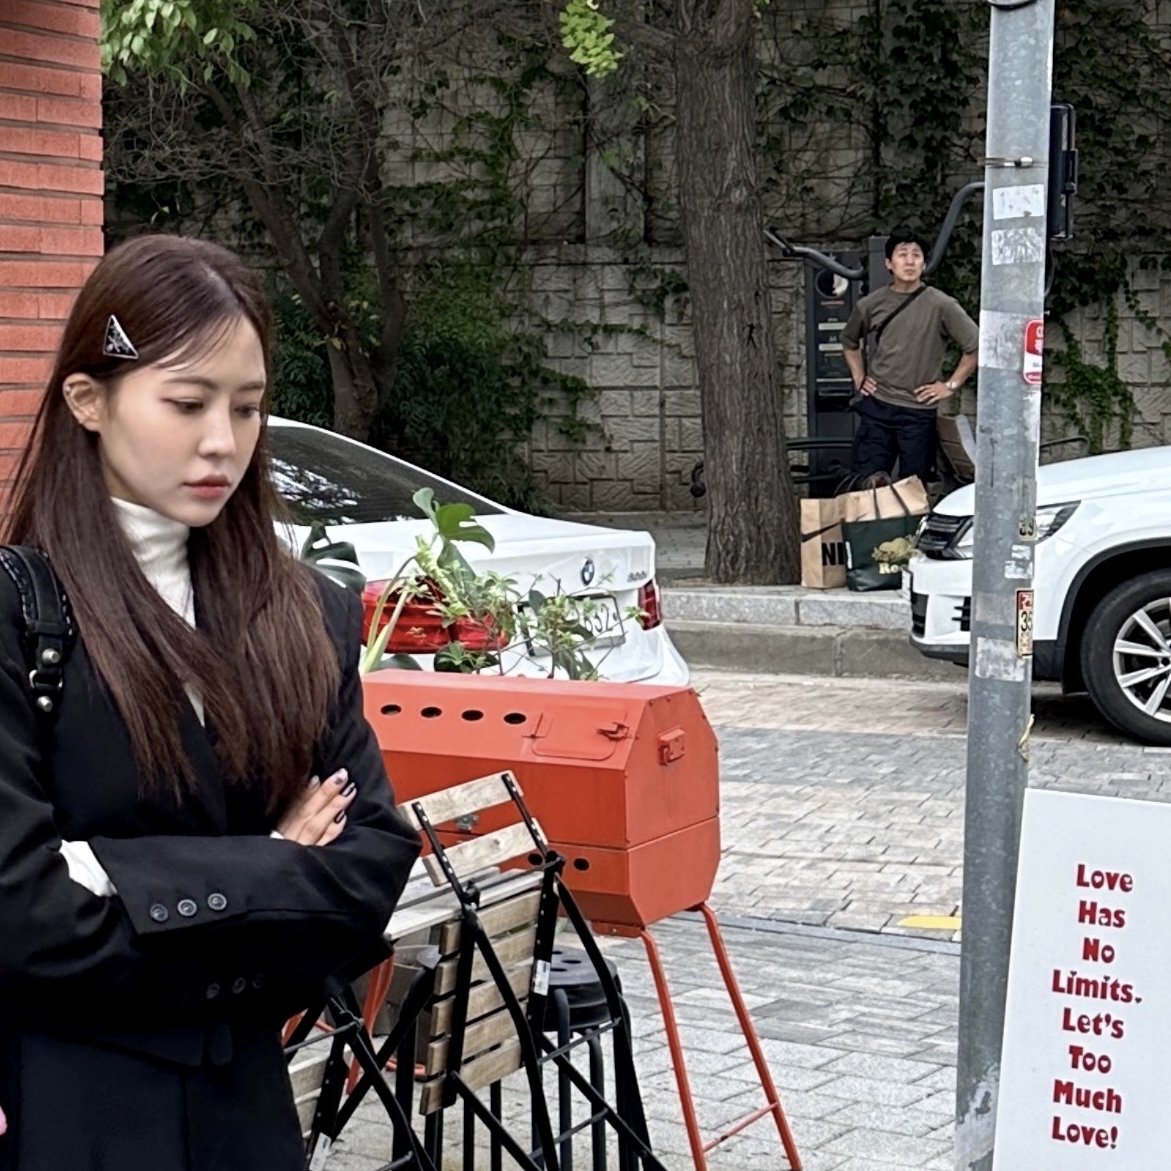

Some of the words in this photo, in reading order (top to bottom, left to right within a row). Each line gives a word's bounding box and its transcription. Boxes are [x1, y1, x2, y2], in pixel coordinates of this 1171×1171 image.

[821, 542, 845, 566] NI
[879, 562, 900, 574] Ro
[1076, 863, 1134, 893] Love
[1078, 899, 1126, 928] Has
[1082, 937, 1115, 964] No
[1052, 969, 1142, 1004] Limits.
[1062, 1007, 1124, 1039] Let's
[1068, 1045, 1112, 1074] Too
[1053, 1079, 1122, 1114] Much
[1052, 1116, 1118, 1150] Love!
